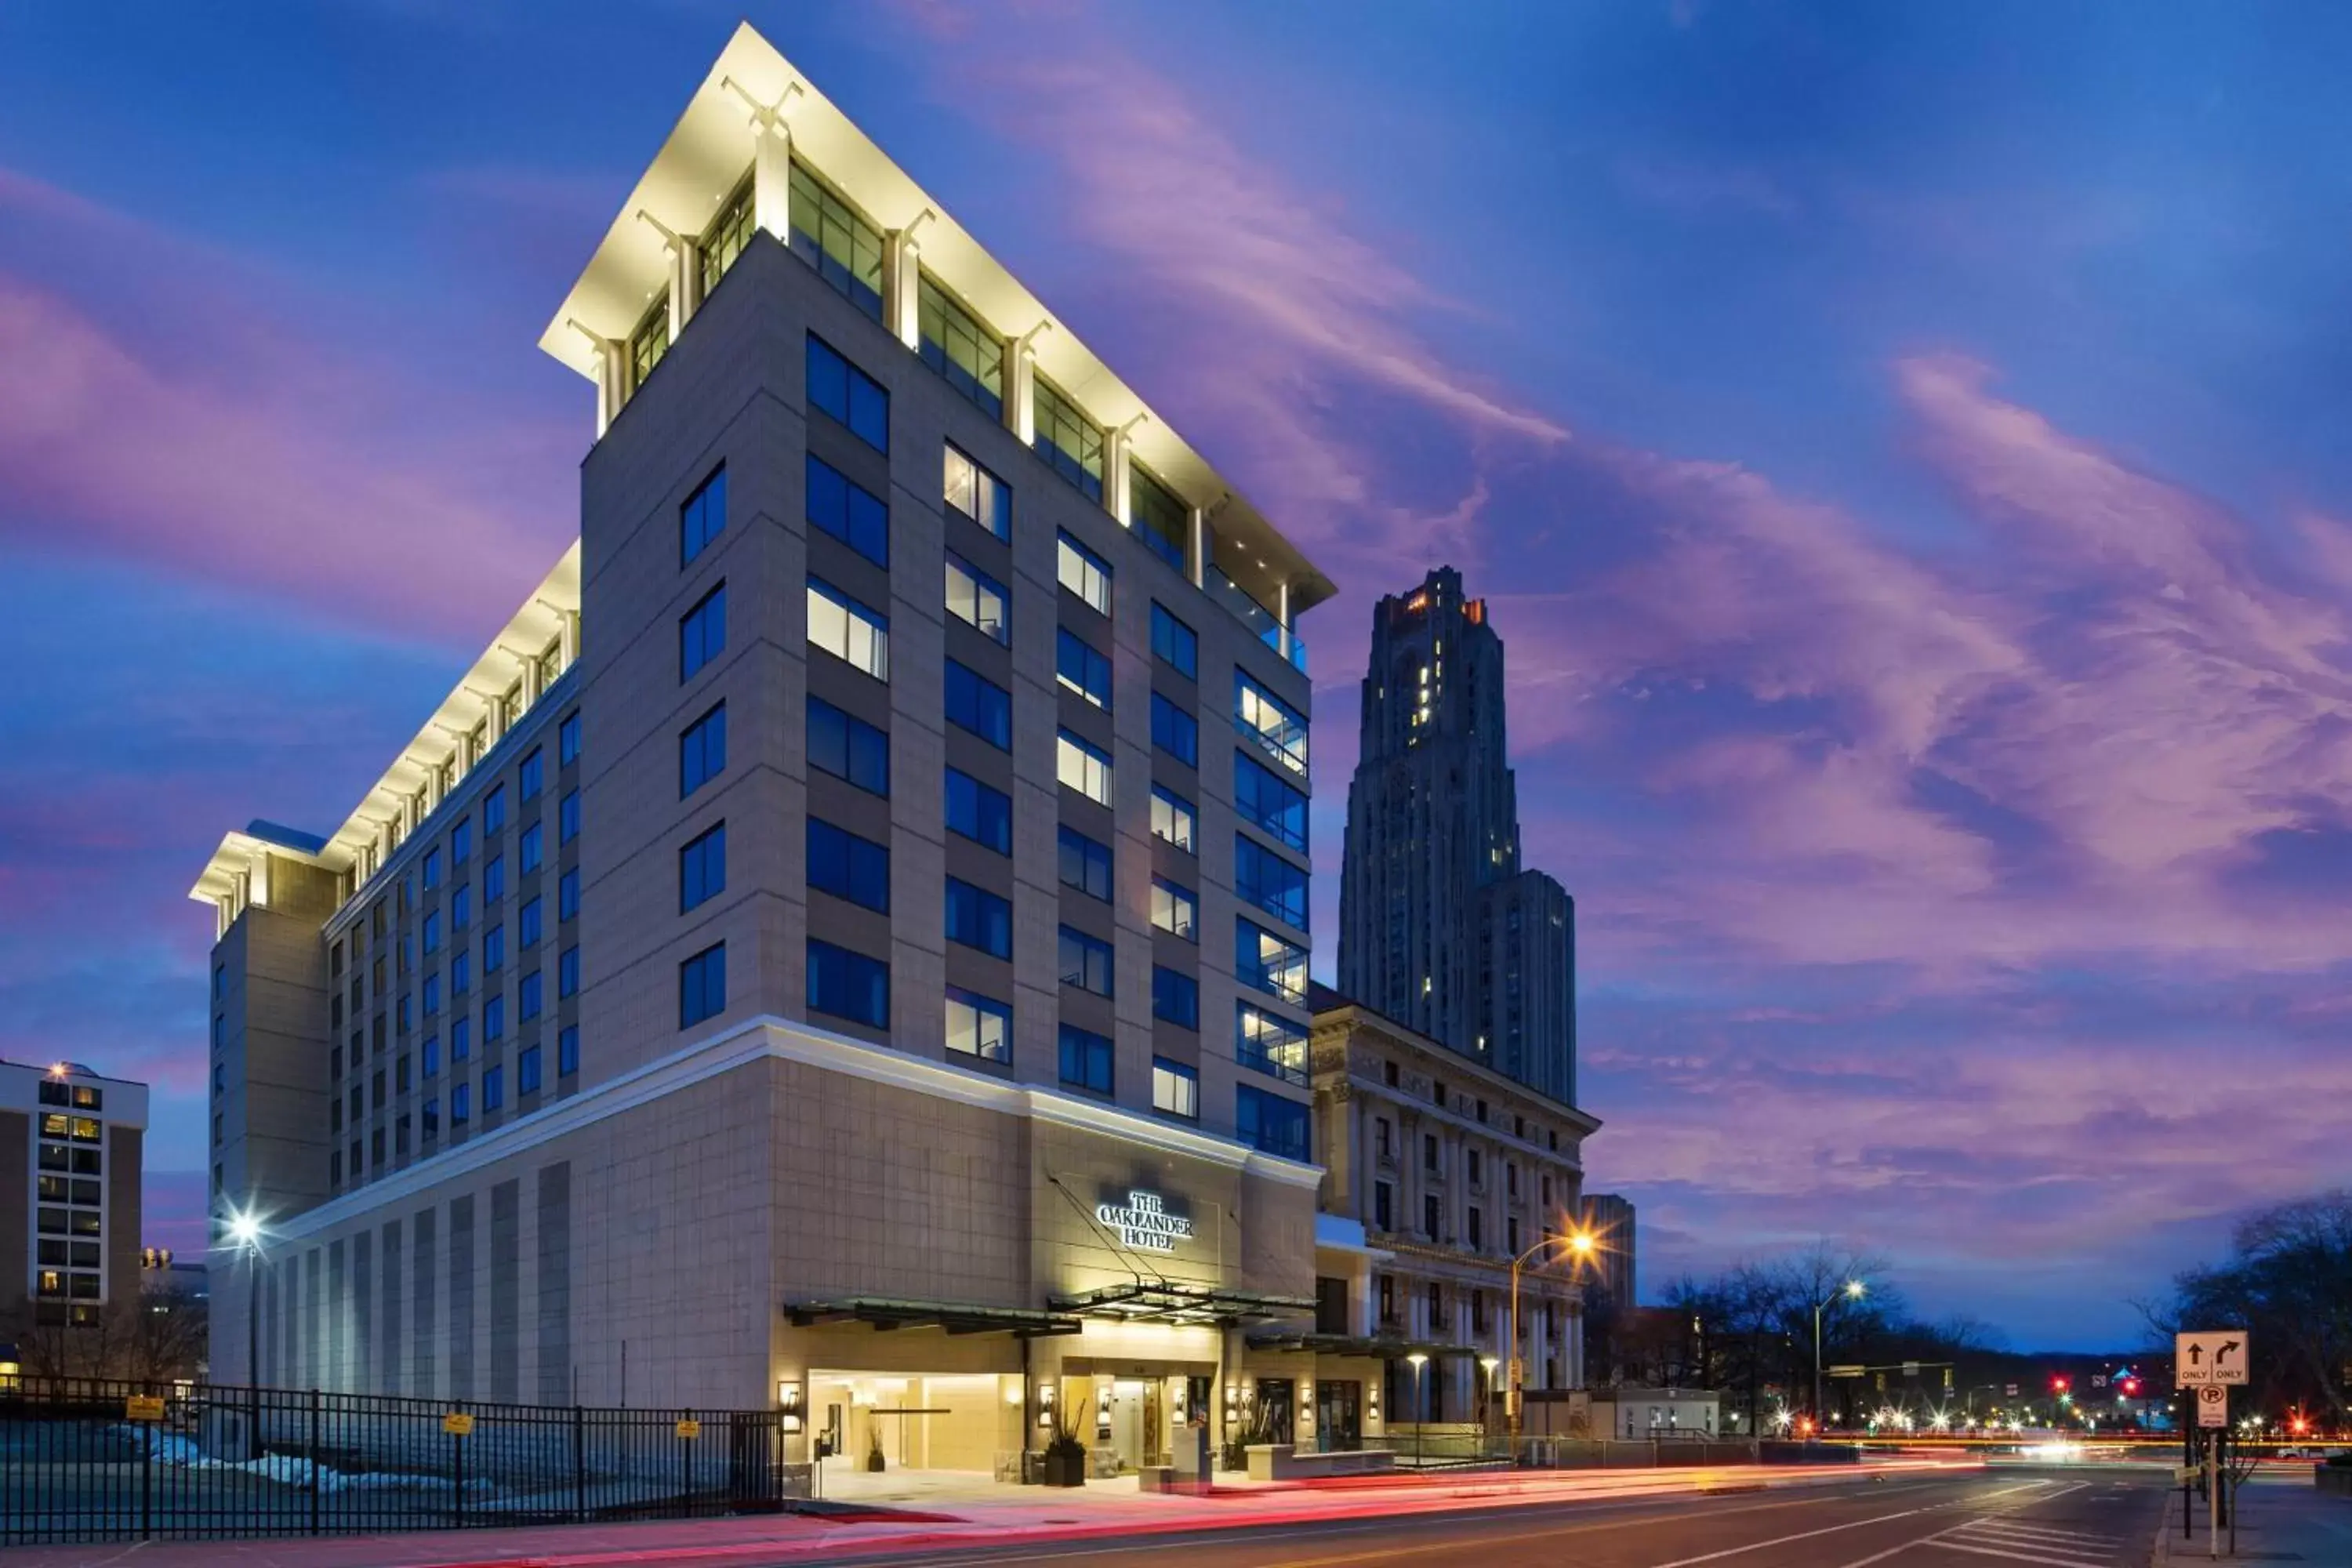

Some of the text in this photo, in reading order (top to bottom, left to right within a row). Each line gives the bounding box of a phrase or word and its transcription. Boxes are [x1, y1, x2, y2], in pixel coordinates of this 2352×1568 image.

[1131, 1192, 1163, 1213] THE
[1099, 1206, 1193, 1236] OAKLANDER
[1124, 1228, 1175, 1251] HOTEL
[2182, 1370, 2208, 1380] ONLY
[2216, 1370, 2242, 1379] ONLY
